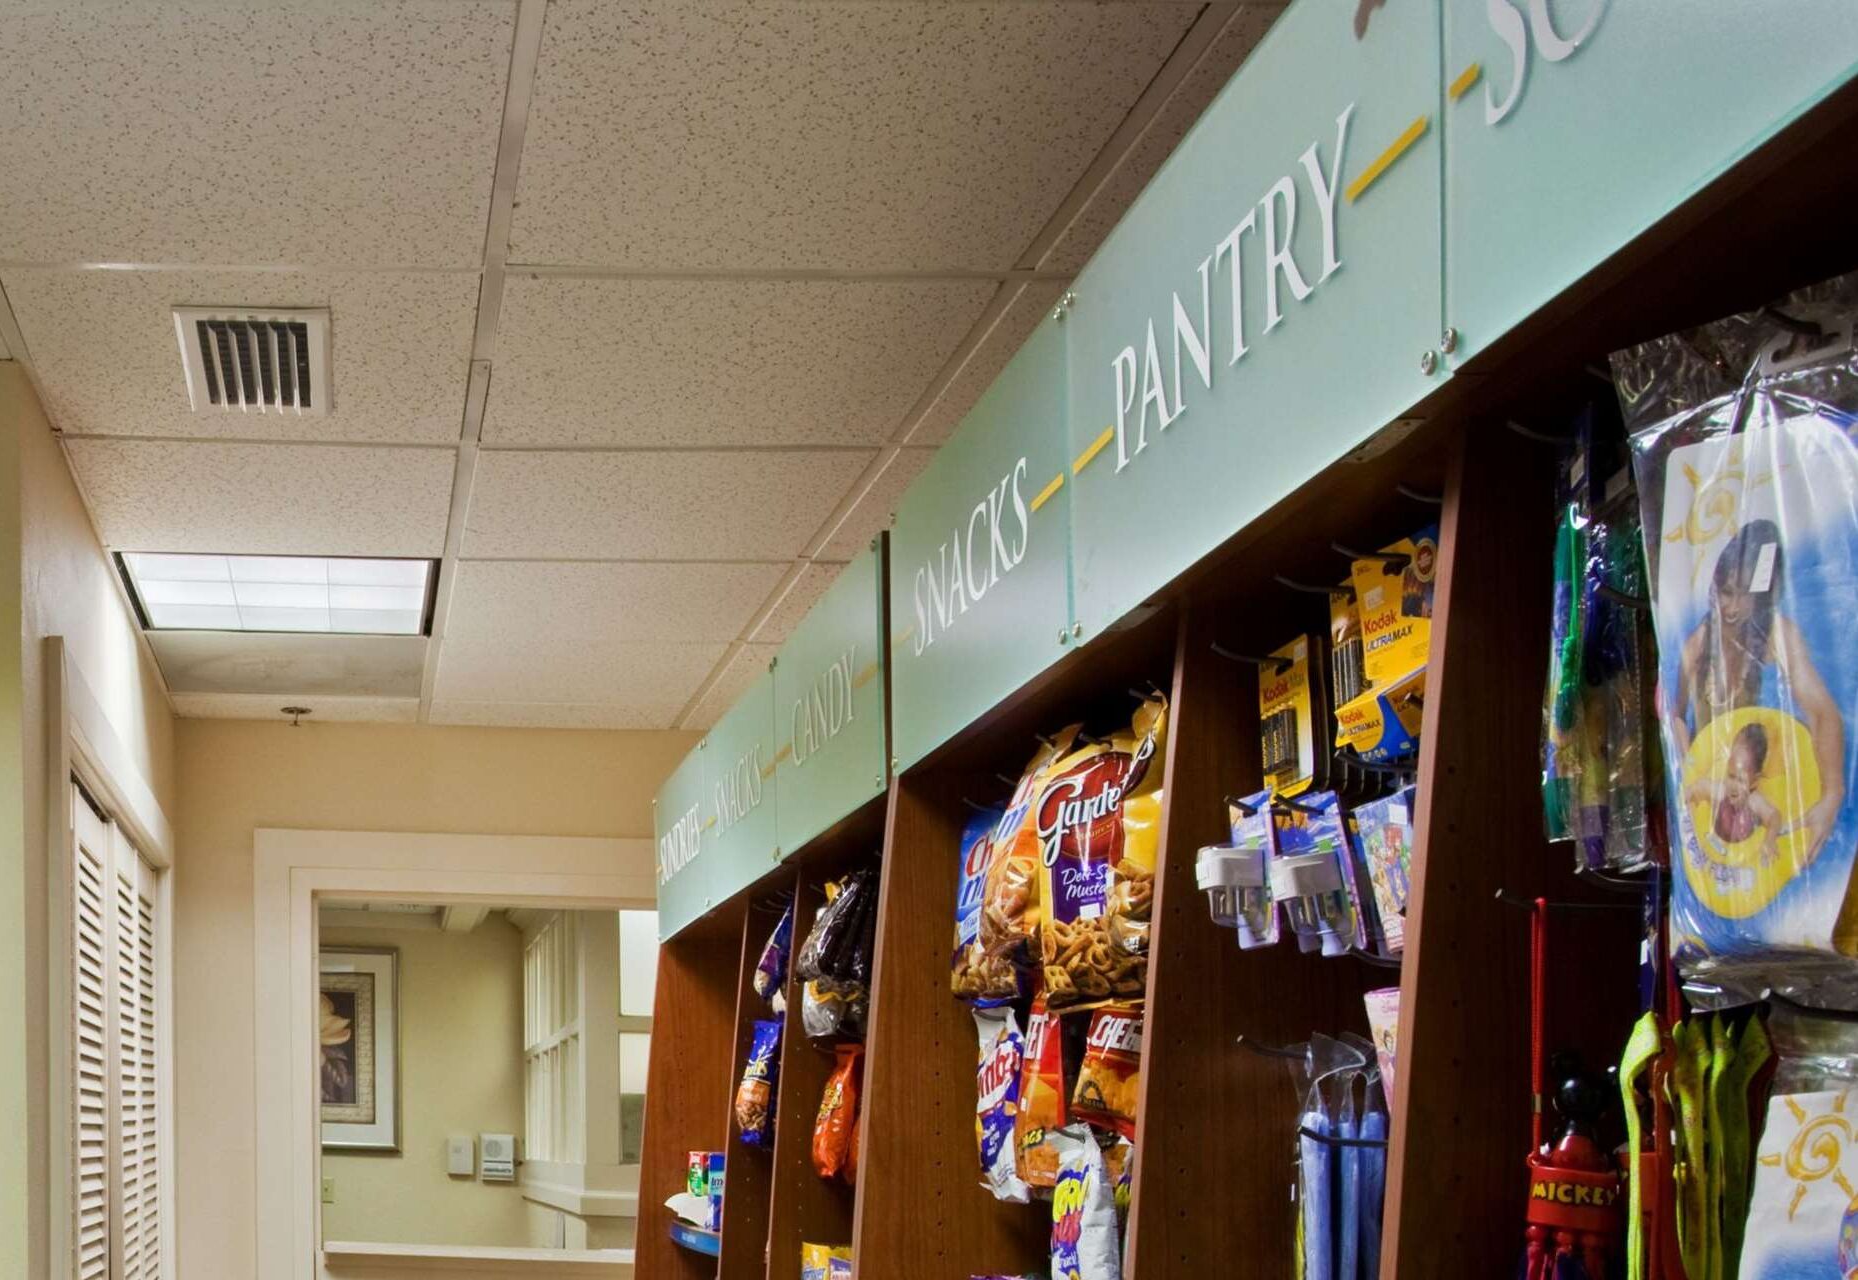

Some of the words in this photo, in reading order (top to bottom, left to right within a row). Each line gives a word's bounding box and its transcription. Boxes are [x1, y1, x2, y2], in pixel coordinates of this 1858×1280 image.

[913, 457, 1029, 656] SNACKS
[1112, 103, 1356, 474] PANTRY
[1364, 609, 1398, 636] Kodak
[1365, 624, 1414, 651] ULTRAMAX
[1263, 677, 1290, 704] Kodak
[1340, 708, 1365, 725] Kodak
[714, 743, 762, 838] SNACKS
[791, 645, 856, 767] CANDY
[1066, 882, 1107, 901] Musta
[1533, 1180, 1618, 1206] MICKEY
